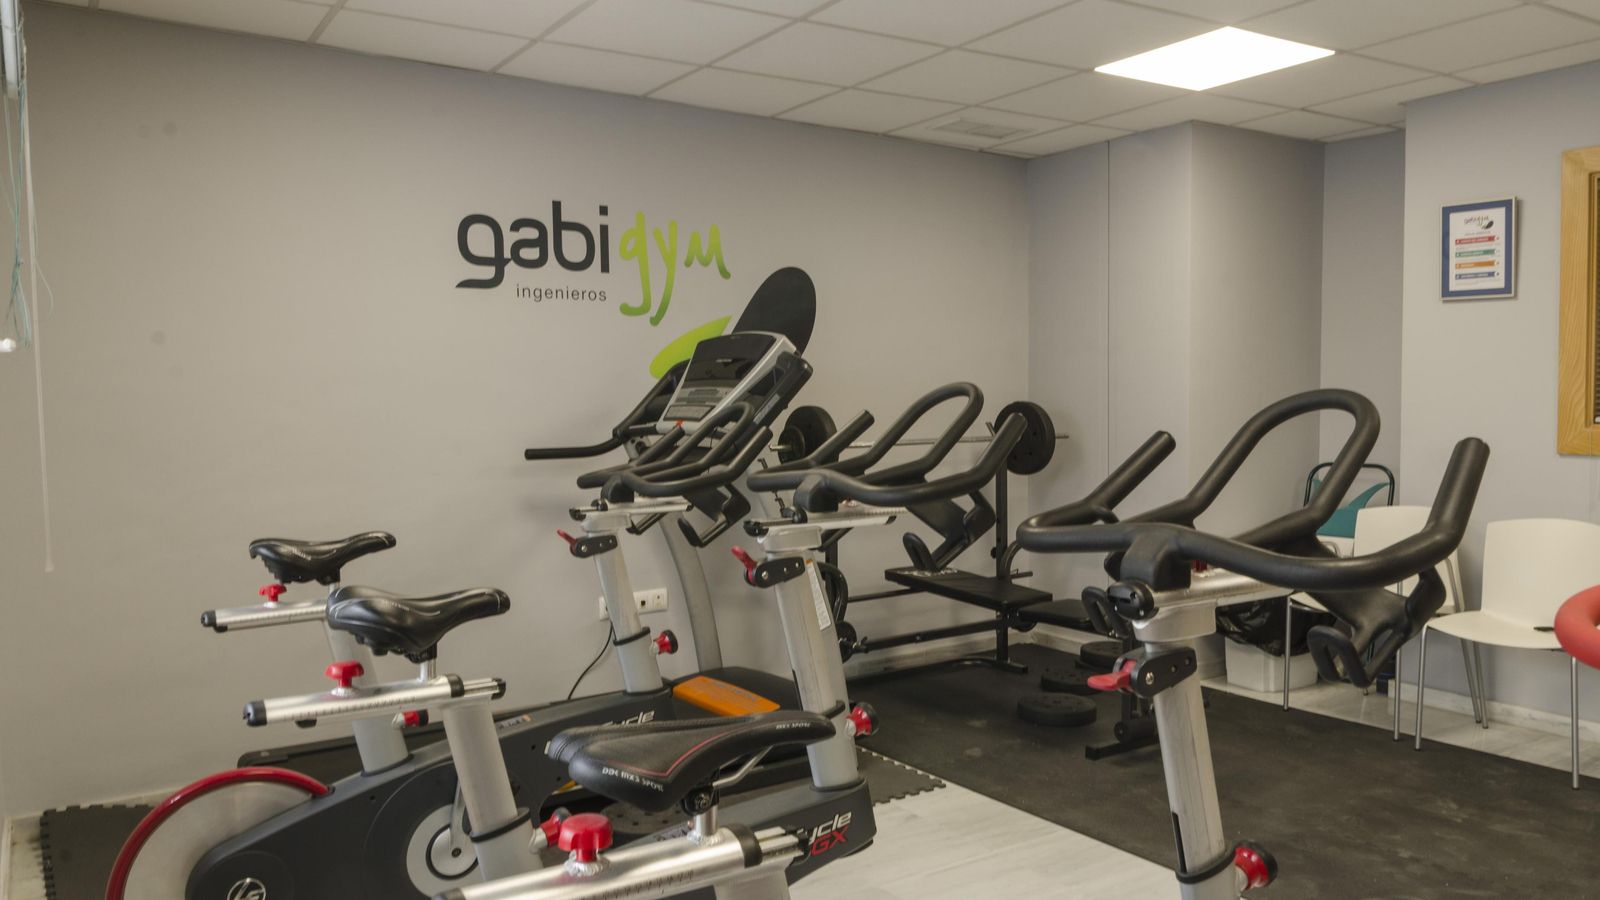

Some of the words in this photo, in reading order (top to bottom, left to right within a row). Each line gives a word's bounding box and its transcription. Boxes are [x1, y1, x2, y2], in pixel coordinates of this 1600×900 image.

[455, 200, 610, 289] gabi
[619, 211, 731, 327] gym
[516, 284, 607, 302] ingenieros
[811, 823, 849, 857] GX
